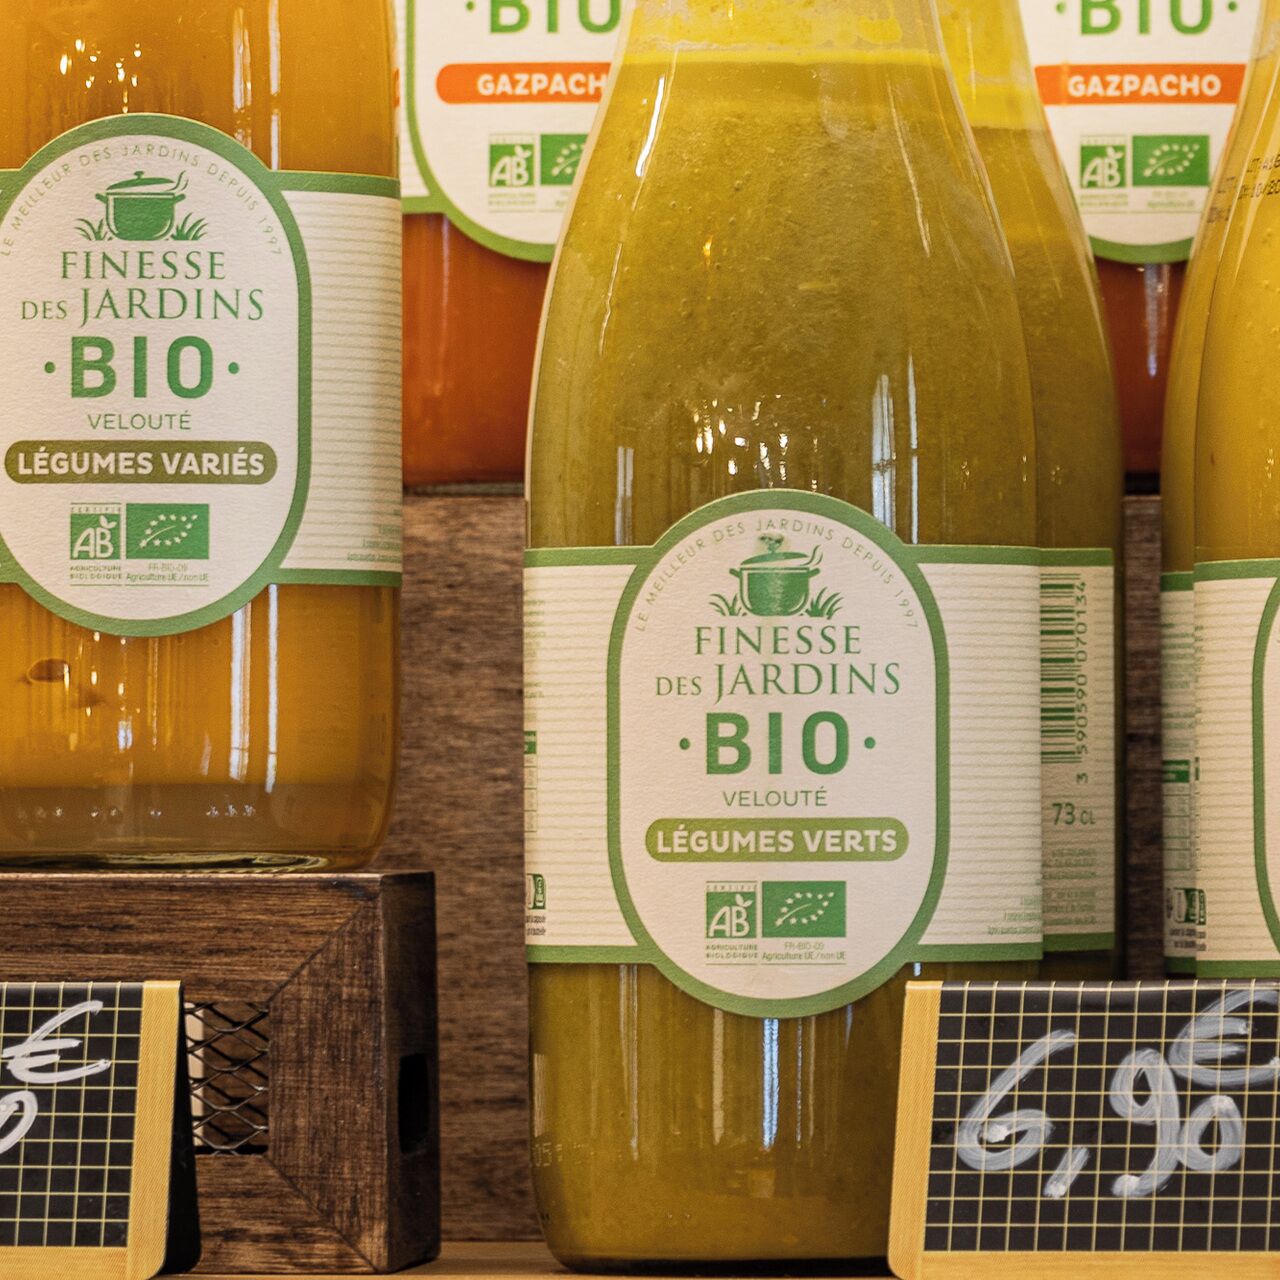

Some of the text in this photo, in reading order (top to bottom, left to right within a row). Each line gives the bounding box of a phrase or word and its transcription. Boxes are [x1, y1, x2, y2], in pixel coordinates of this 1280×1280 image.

[477, 73, 606, 96] GAZPACH
[1069, 75, 1221, 96] GAZPACHO
[80, 144, 112, 168] DES
[121, 143, 201, 168] JARDINS
[207, 163, 258, 211] DEPUIS
[492, 156, 529, 185] AB
[1083, 157, 1120, 187] AB
[61, 251, 226, 280] FINESSE
[21, 289, 264, 328] DES JARDINS
[71, 335, 213, 398] BIO
[88, 411, 192, 430] VELOUTÉ
[18, 447, 265, 476] LÉGUMES VARIÉS
[72, 527, 113, 558] AB
[713, 522, 745, 541] DES
[756, 518, 835, 540] JARDINS
[842, 538, 894, 583] DEPUIS
[695, 626, 861, 655] FINESSE
[656, 663, 901, 704] DES JARDINS
[706, 711, 849, 775] BIO
[1076, 773, 1088, 783] 3
[723, 787, 828, 807] VELOUTÉ
[1052, 802, 1077, 826] 73
[657, 825, 897, 853] LÉGUMES VERTS
[709, 906, 750, 937] AB
